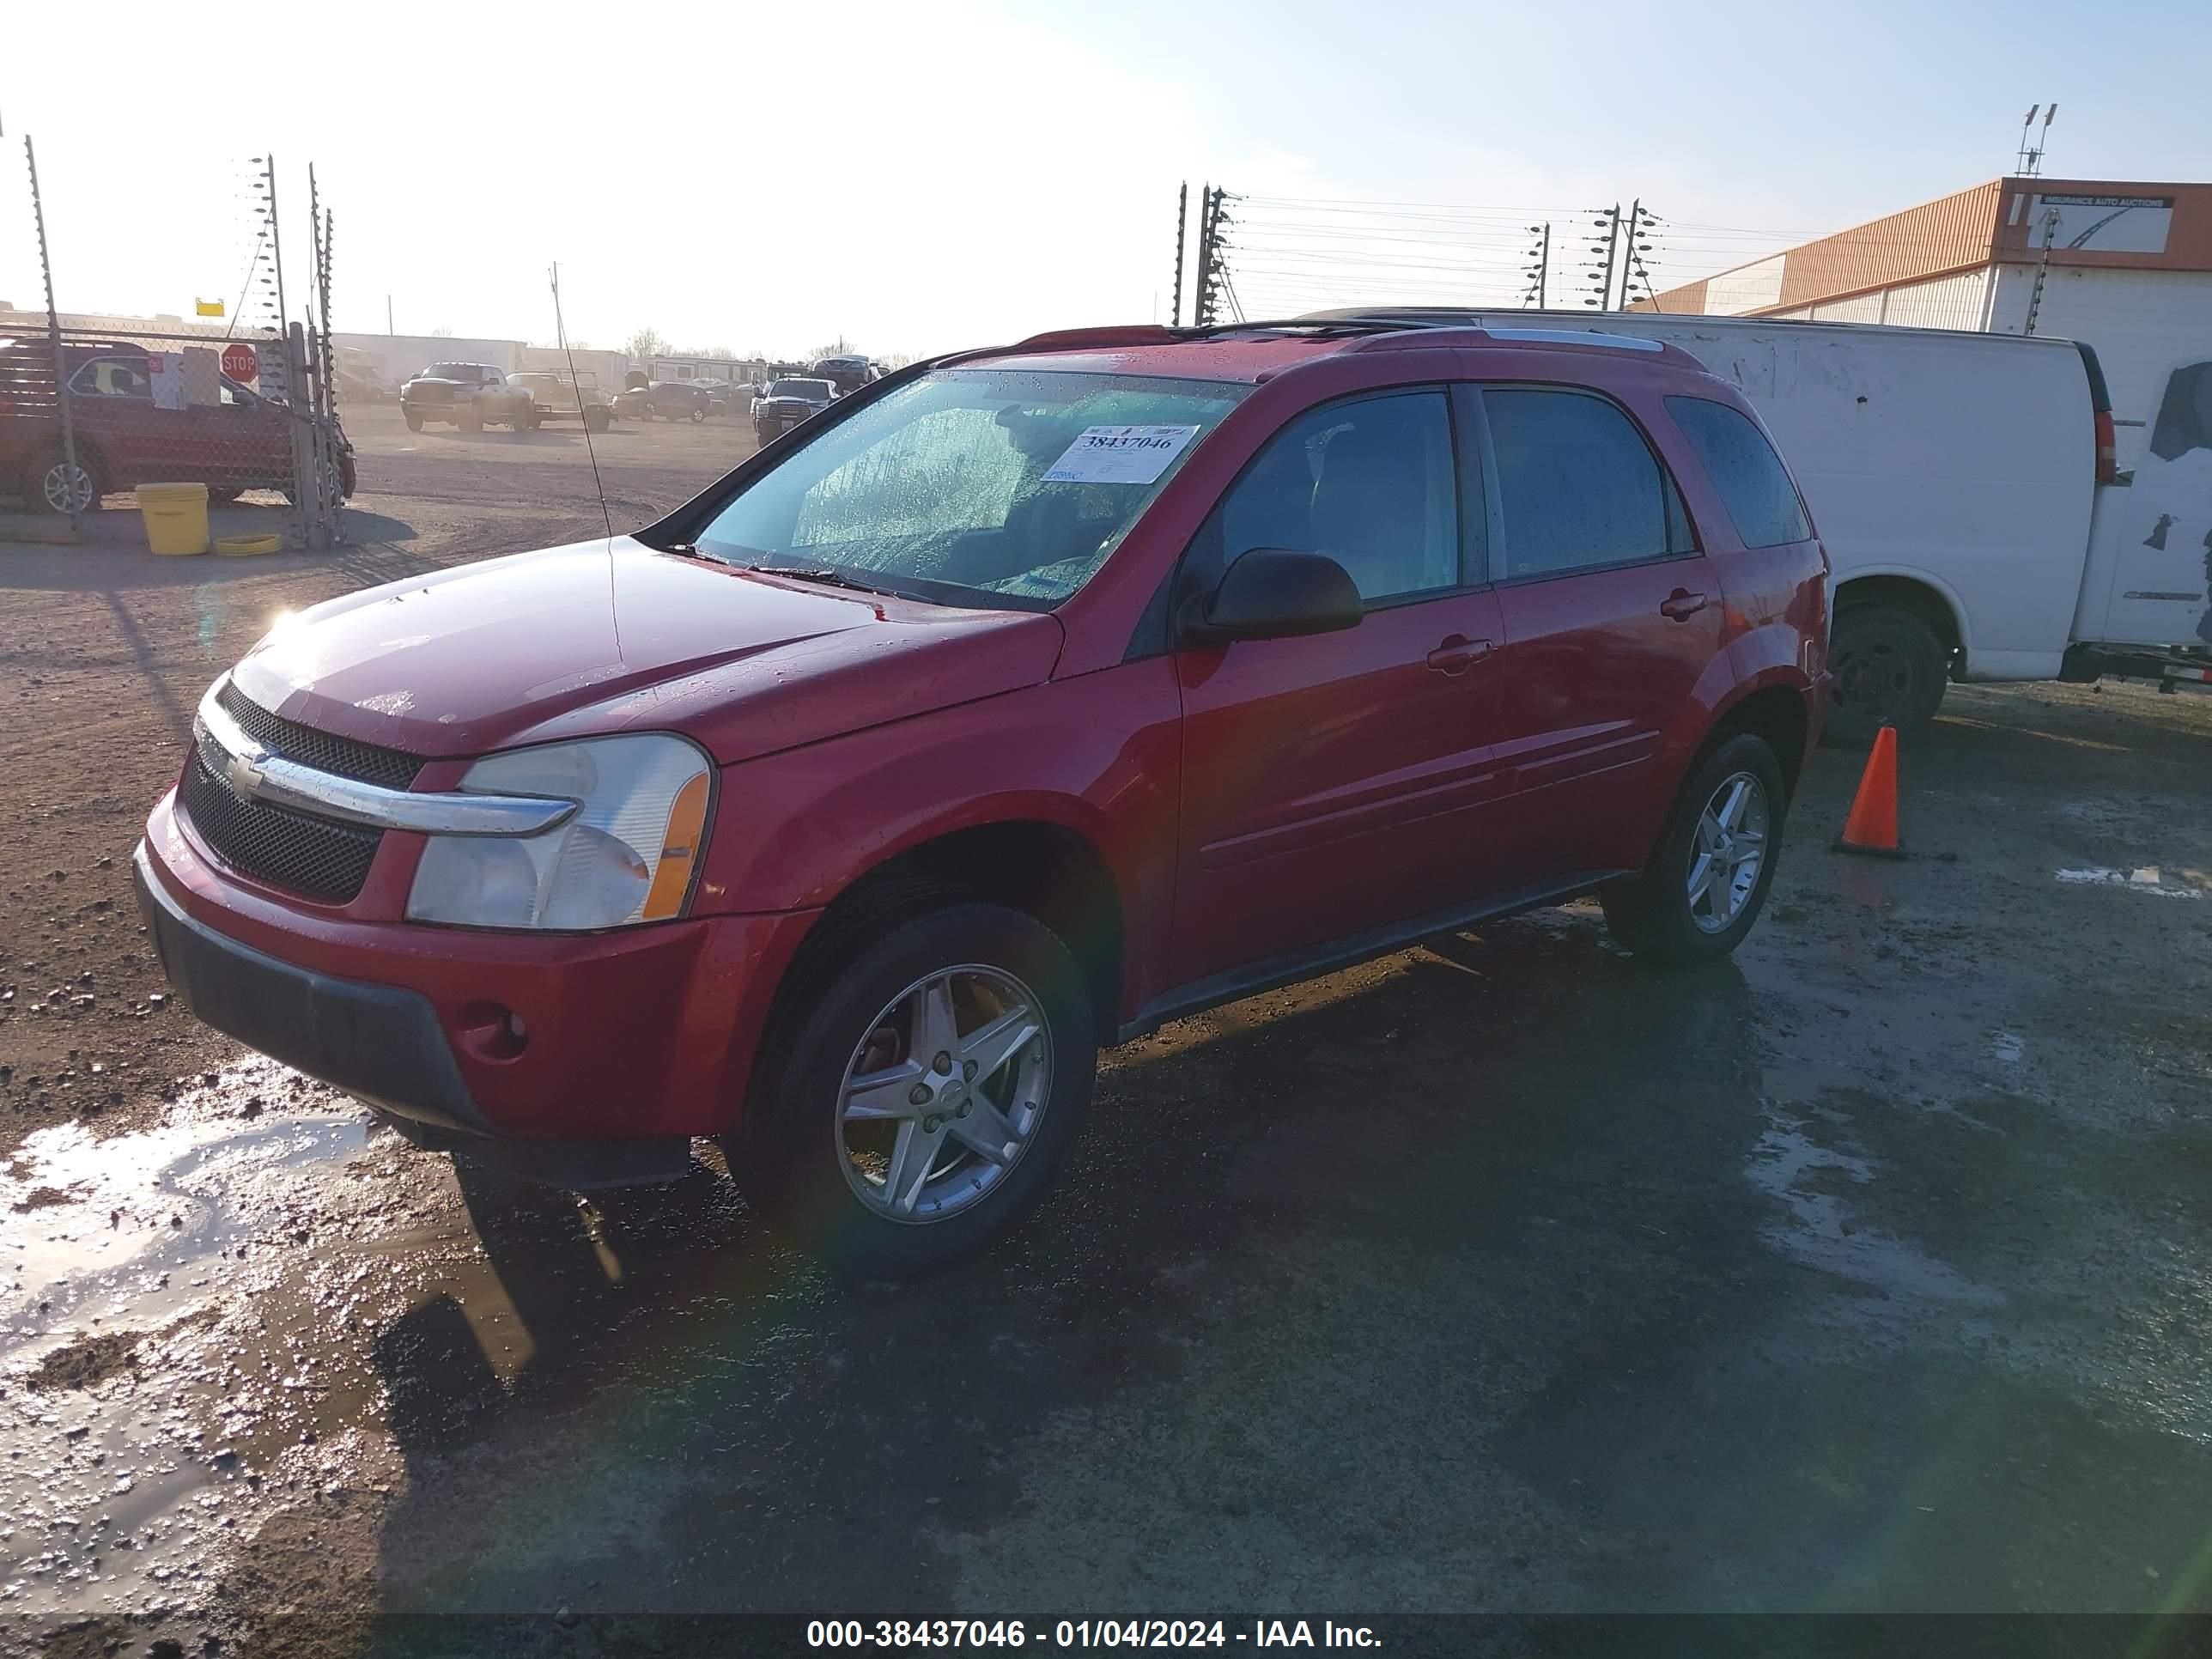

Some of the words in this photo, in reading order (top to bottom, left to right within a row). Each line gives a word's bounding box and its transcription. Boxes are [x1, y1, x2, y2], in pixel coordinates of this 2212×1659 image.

[2045, 197, 2094, 206] INSURANCE
[2094, 198, 2118, 206] AUTO
[2119, 198, 2164, 208] AUCTIONS
[223, 356, 255, 372] STOP
[1082, 435, 1176, 450] 38437046
